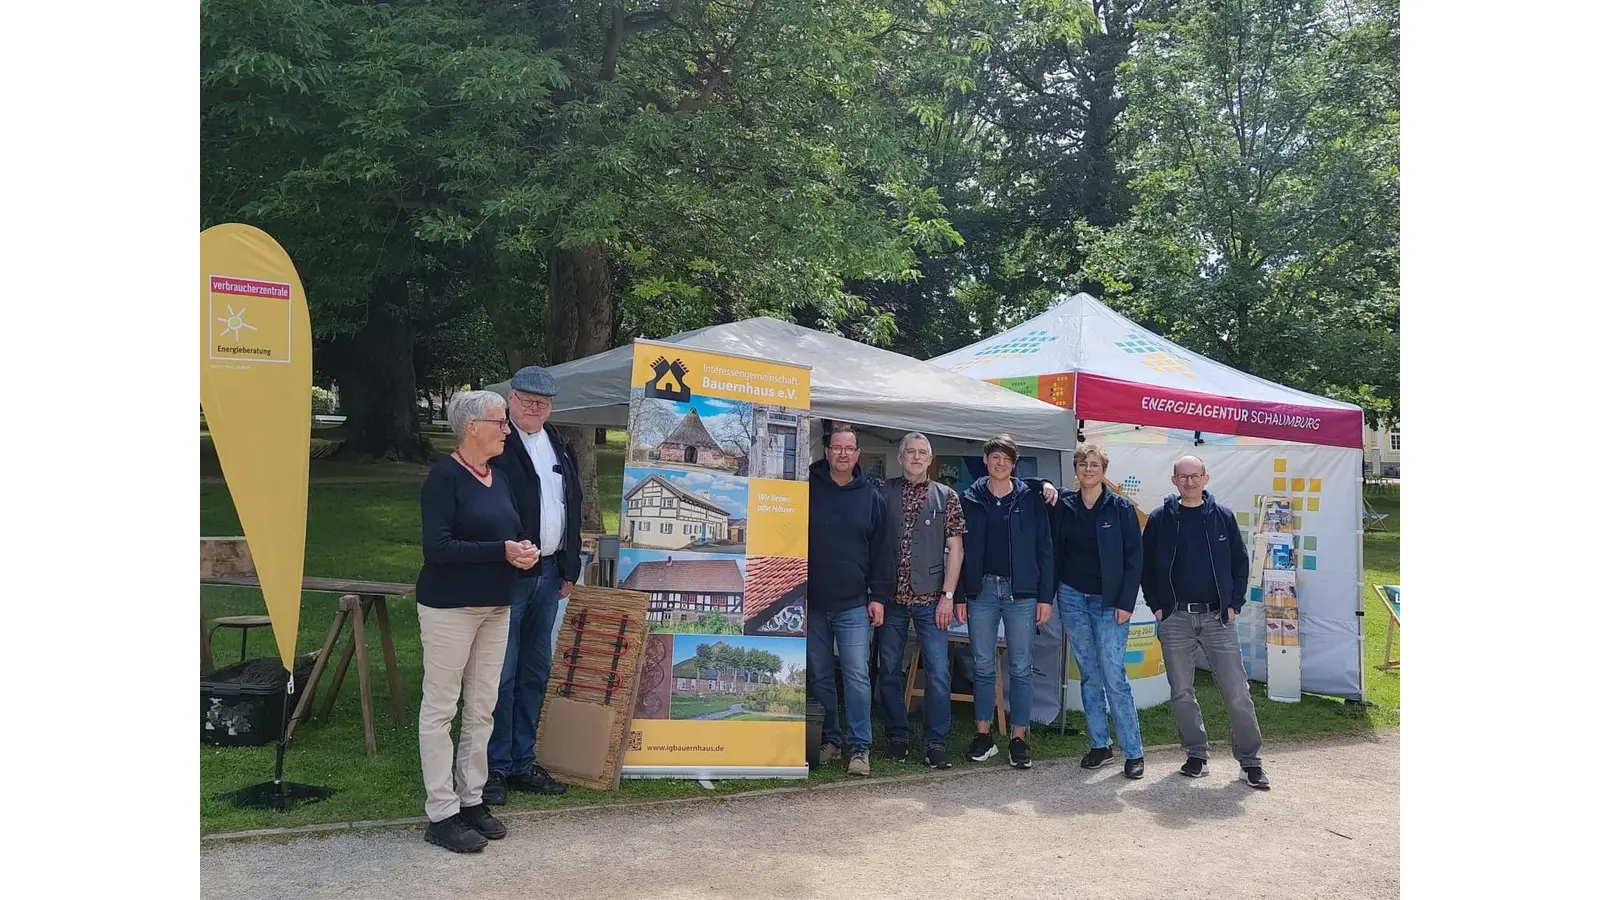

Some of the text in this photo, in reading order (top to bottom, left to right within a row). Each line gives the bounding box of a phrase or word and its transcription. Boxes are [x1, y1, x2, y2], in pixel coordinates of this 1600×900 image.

[212, 280, 289, 297] verbraucherzentrale
[217, 345, 272, 356] Energieberatung
[703, 364, 798, 385] Interessengemeinschaft
[702, 376, 798, 400] Bauernhaus e.V.
[1141, 396, 1321, 430] ENERGIEAGENTUR SCHAUMBURG
[646, 744, 725, 753] www.igbauernhaus.de
